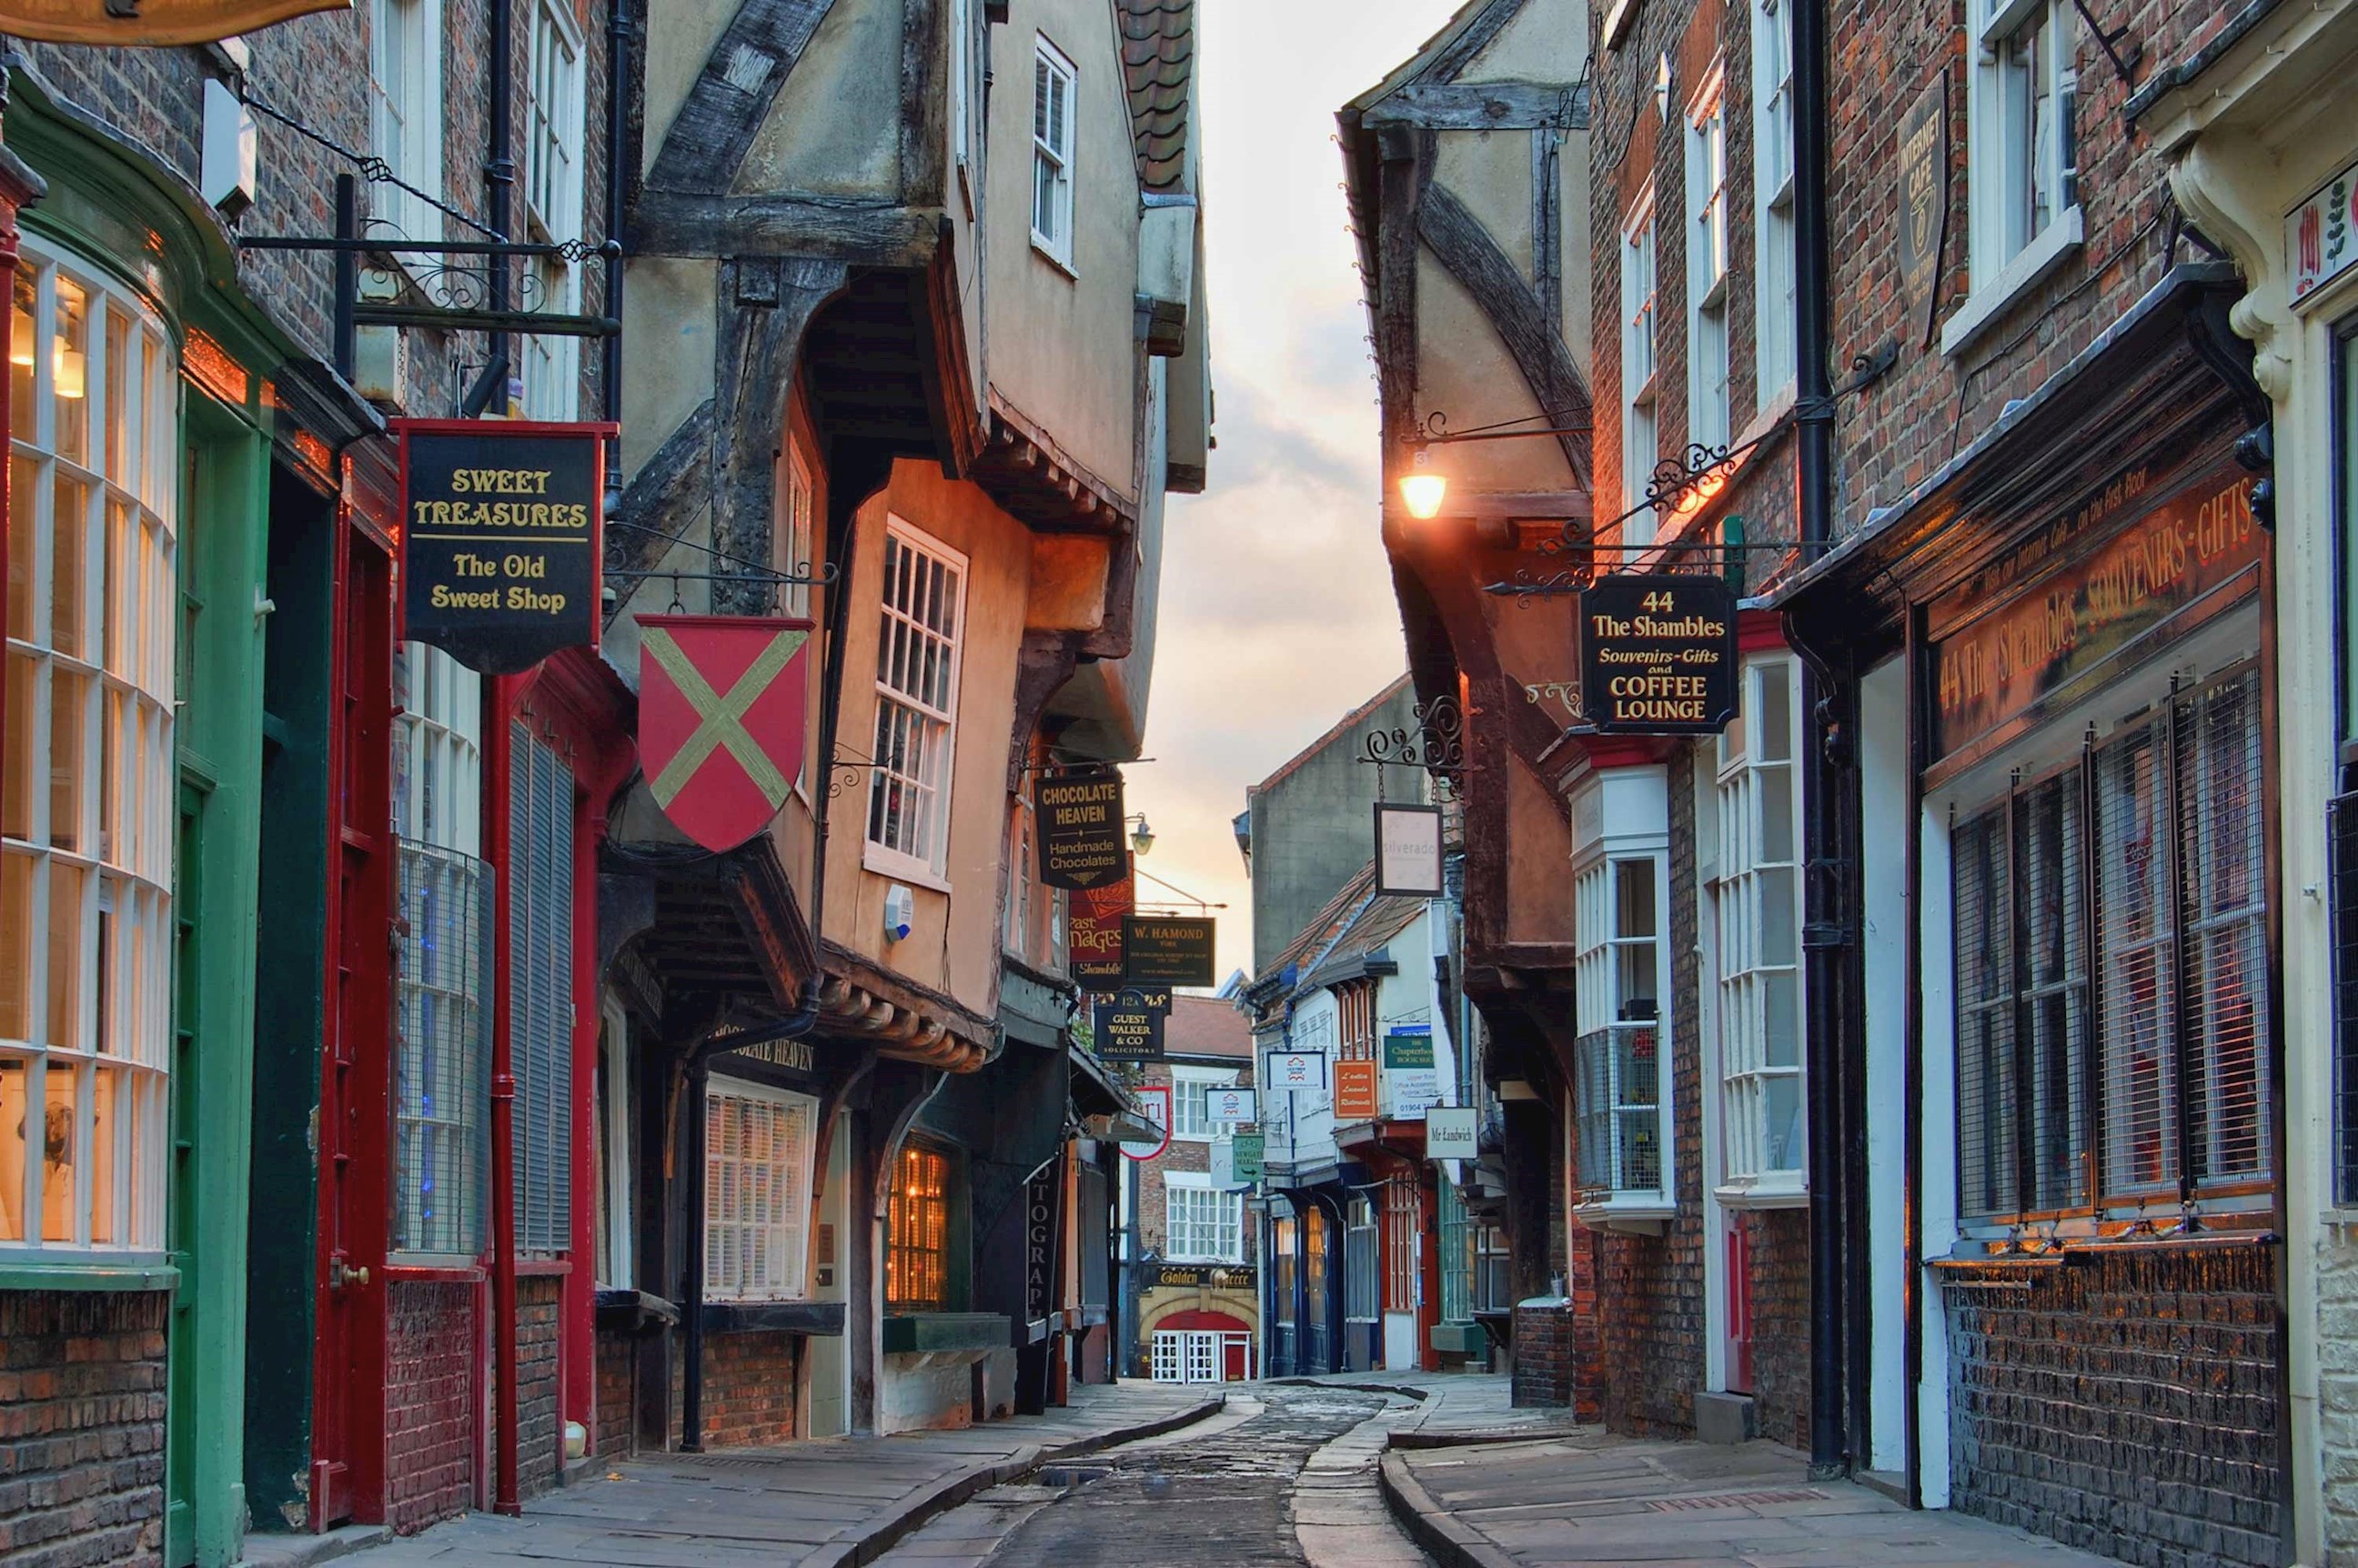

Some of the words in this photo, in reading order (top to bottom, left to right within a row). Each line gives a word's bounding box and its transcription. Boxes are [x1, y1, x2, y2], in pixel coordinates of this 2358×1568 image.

[1900, 107, 1940, 176] INTERNET
[451, 468, 551, 494] SWEET
[414, 500, 587, 528] TREASURES
[453, 553, 497, 577] The
[503, 555, 545, 578] Old
[430, 585, 500, 608] Sweet
[507, 587, 566, 615] Shop
[1642, 591, 1674, 612] 44
[1593, 615, 1630, 637] The
[1634, 616, 1725, 637] Shambles
[1648, 666, 1672, 674] and
[1940, 649, 1960, 709] 44
[1964, 639, 1989, 699] Th
[1610, 677, 1707, 697] COFFEE
[1617, 700, 1706, 719] LOUNGE
[1042, 783, 1116, 805] CHOCOLATE
[1055, 805, 1105, 825] HEAVEN
[1050, 839, 1114, 856] Handmade
[1384, 839, 1436, 855] silverado
[1050, 854, 1116, 870] Chocolates
[1134, 926, 1149, 939] W.
[1152, 928, 1204, 940] HAMOND
[1078, 962, 1123, 975] Shamble
[1113, 1014, 1147, 1024] GUEST
[1108, 1025, 1152, 1034] WALKER
[1116, 1037, 1124, 1045] &
[1126, 1036, 1144, 1045] CO
[774, 1039, 814, 1071] HEAVEN
[1431, 1128, 1441, 1141] Mr
[1161, 1271, 1198, 1284] Golden
[1224, 1274, 1248, 1285] eece
